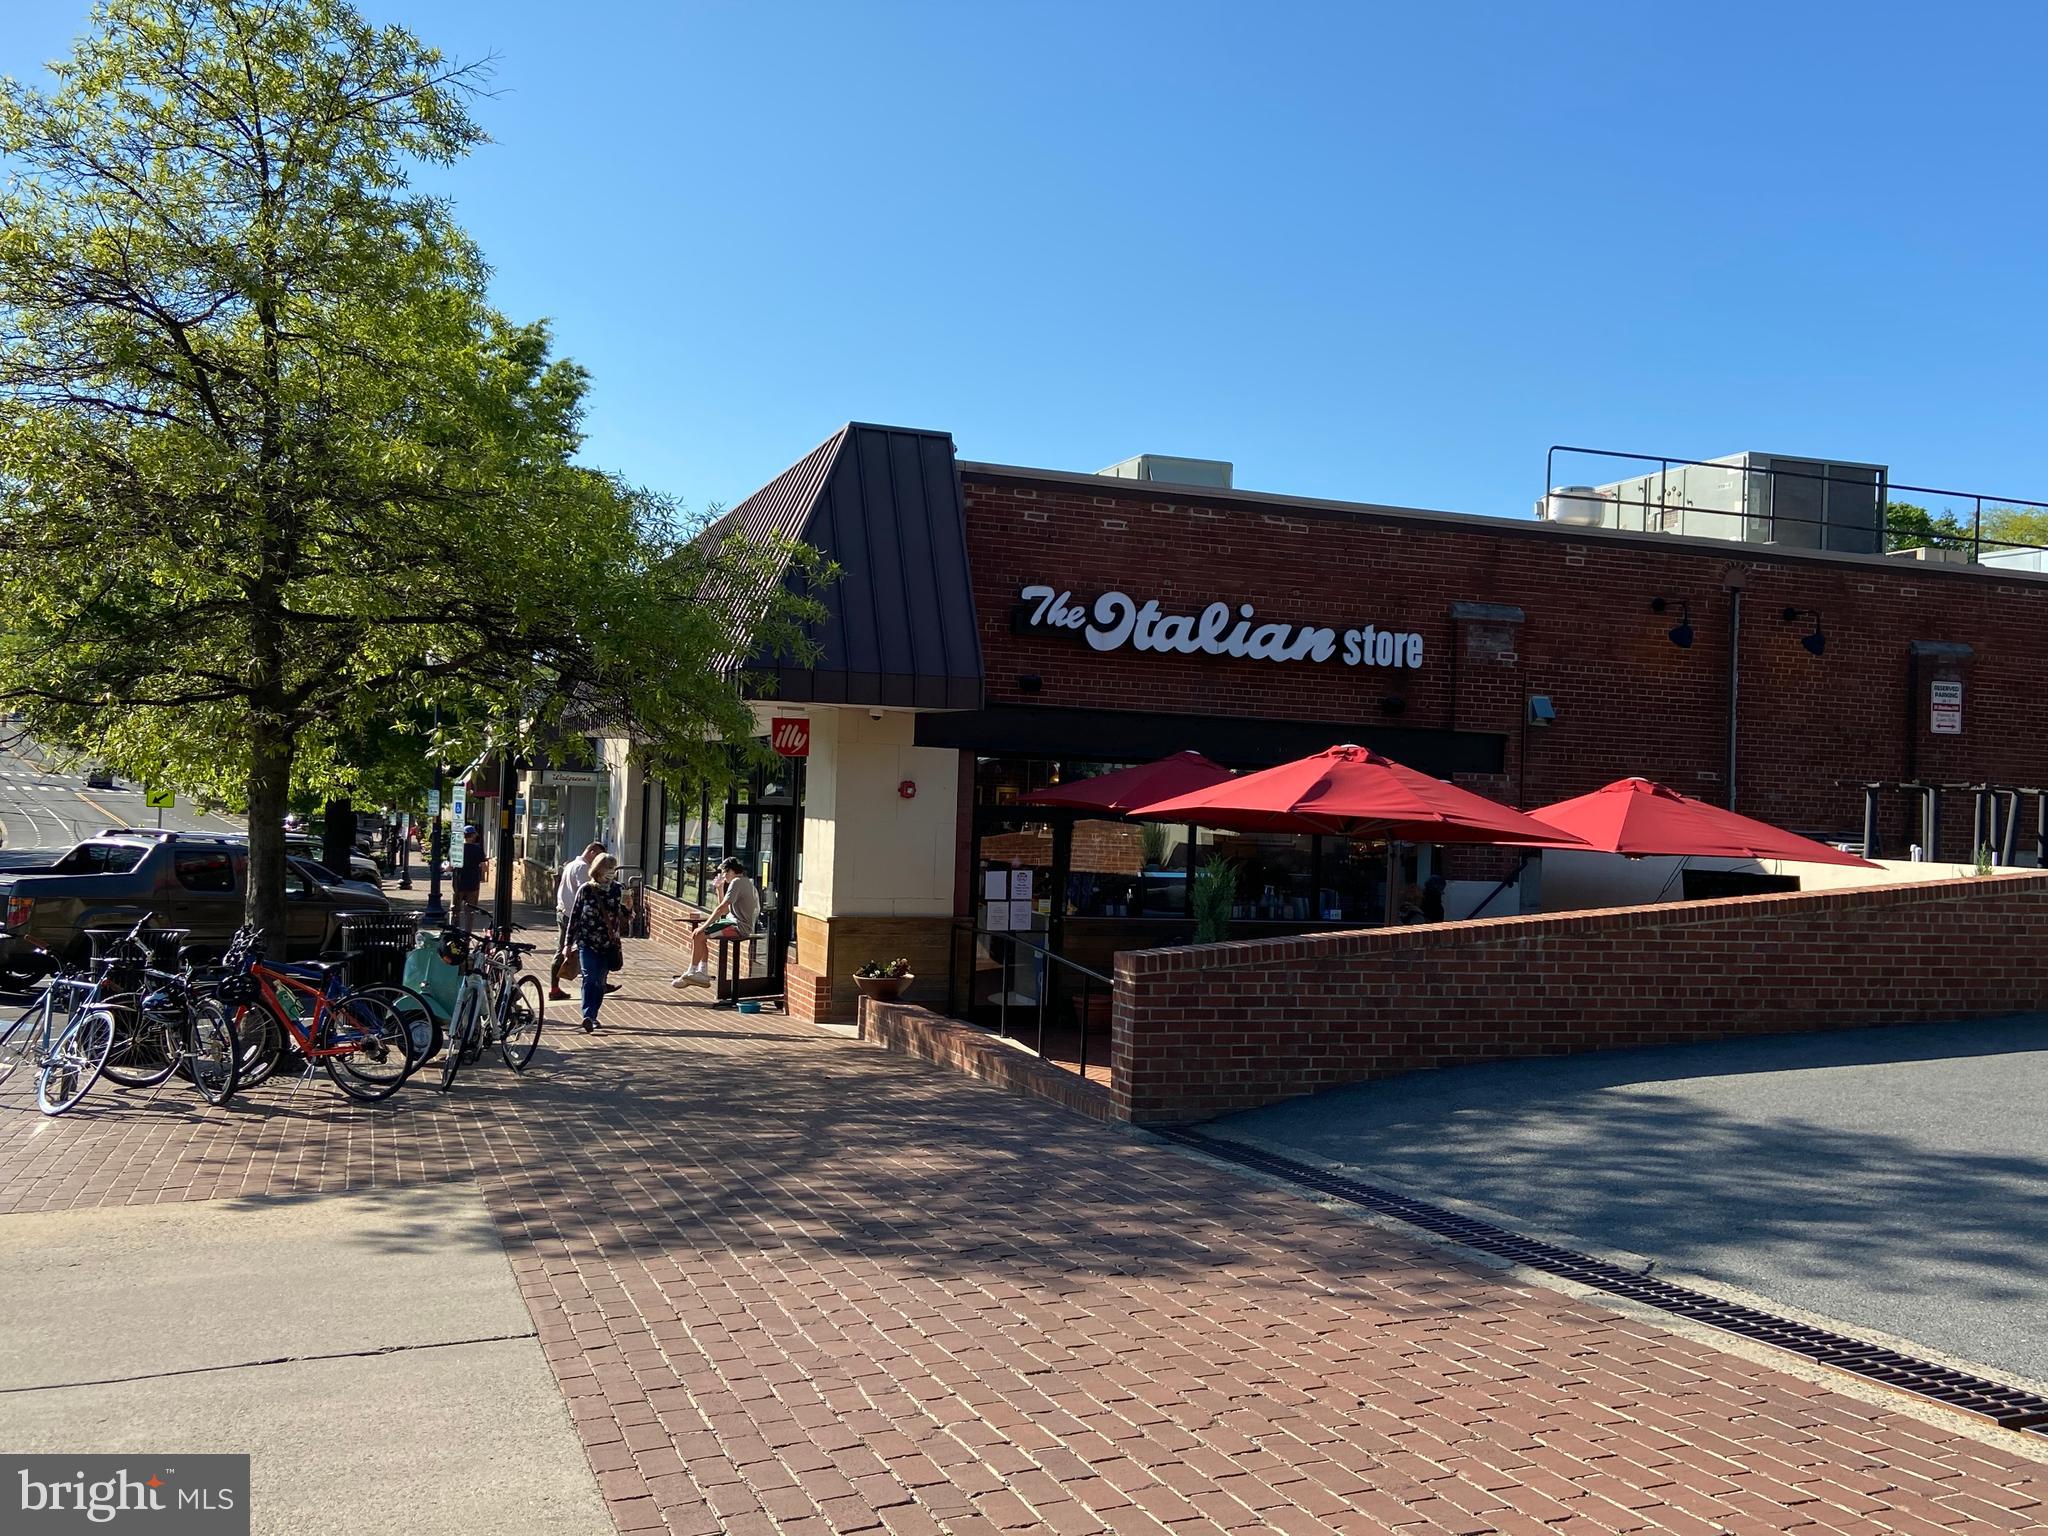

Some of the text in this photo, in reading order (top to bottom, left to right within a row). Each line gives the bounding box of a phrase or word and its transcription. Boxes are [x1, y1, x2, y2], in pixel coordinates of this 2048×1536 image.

[1021, 585, 1424, 669] The Italian store
[775, 723, 808, 754] illy
[552, 773, 593, 783] Walgreens
